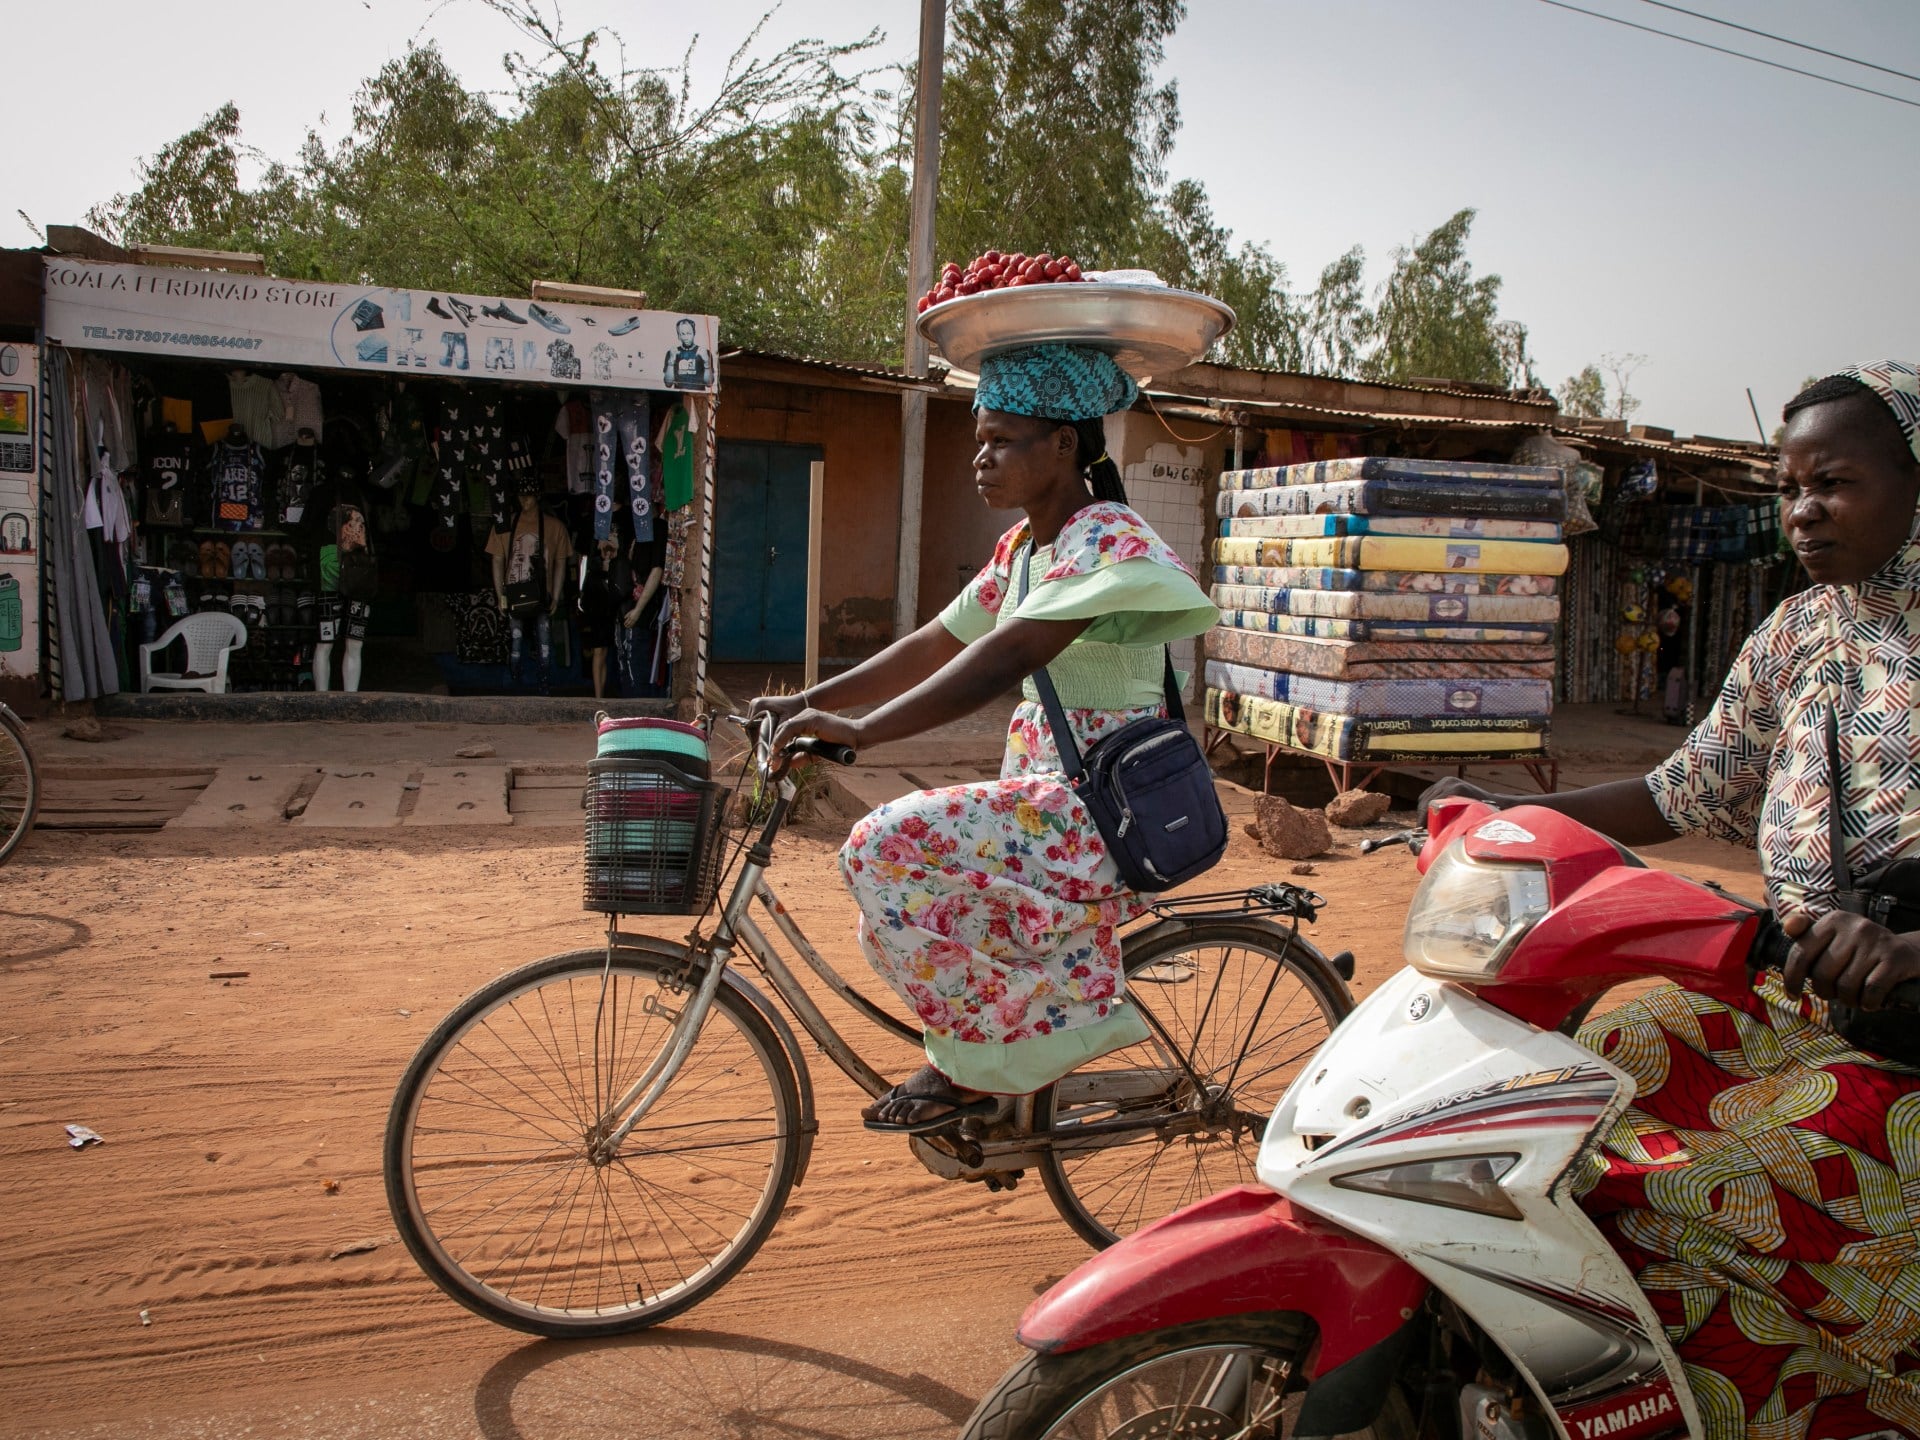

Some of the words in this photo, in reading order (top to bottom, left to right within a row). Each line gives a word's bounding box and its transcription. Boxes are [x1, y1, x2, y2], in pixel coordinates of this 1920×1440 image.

[45, 268, 126, 291] KOALA
[136, 276, 258, 302] FERDINAD
[266, 287, 344, 308] STORE
[1373, 719, 1411, 731] L'Artisan
[1430, 718, 1460, 730] confort
[1481, 719, 1493, 729] de
[1576, 1393, 1674, 1440] YAMAHA
